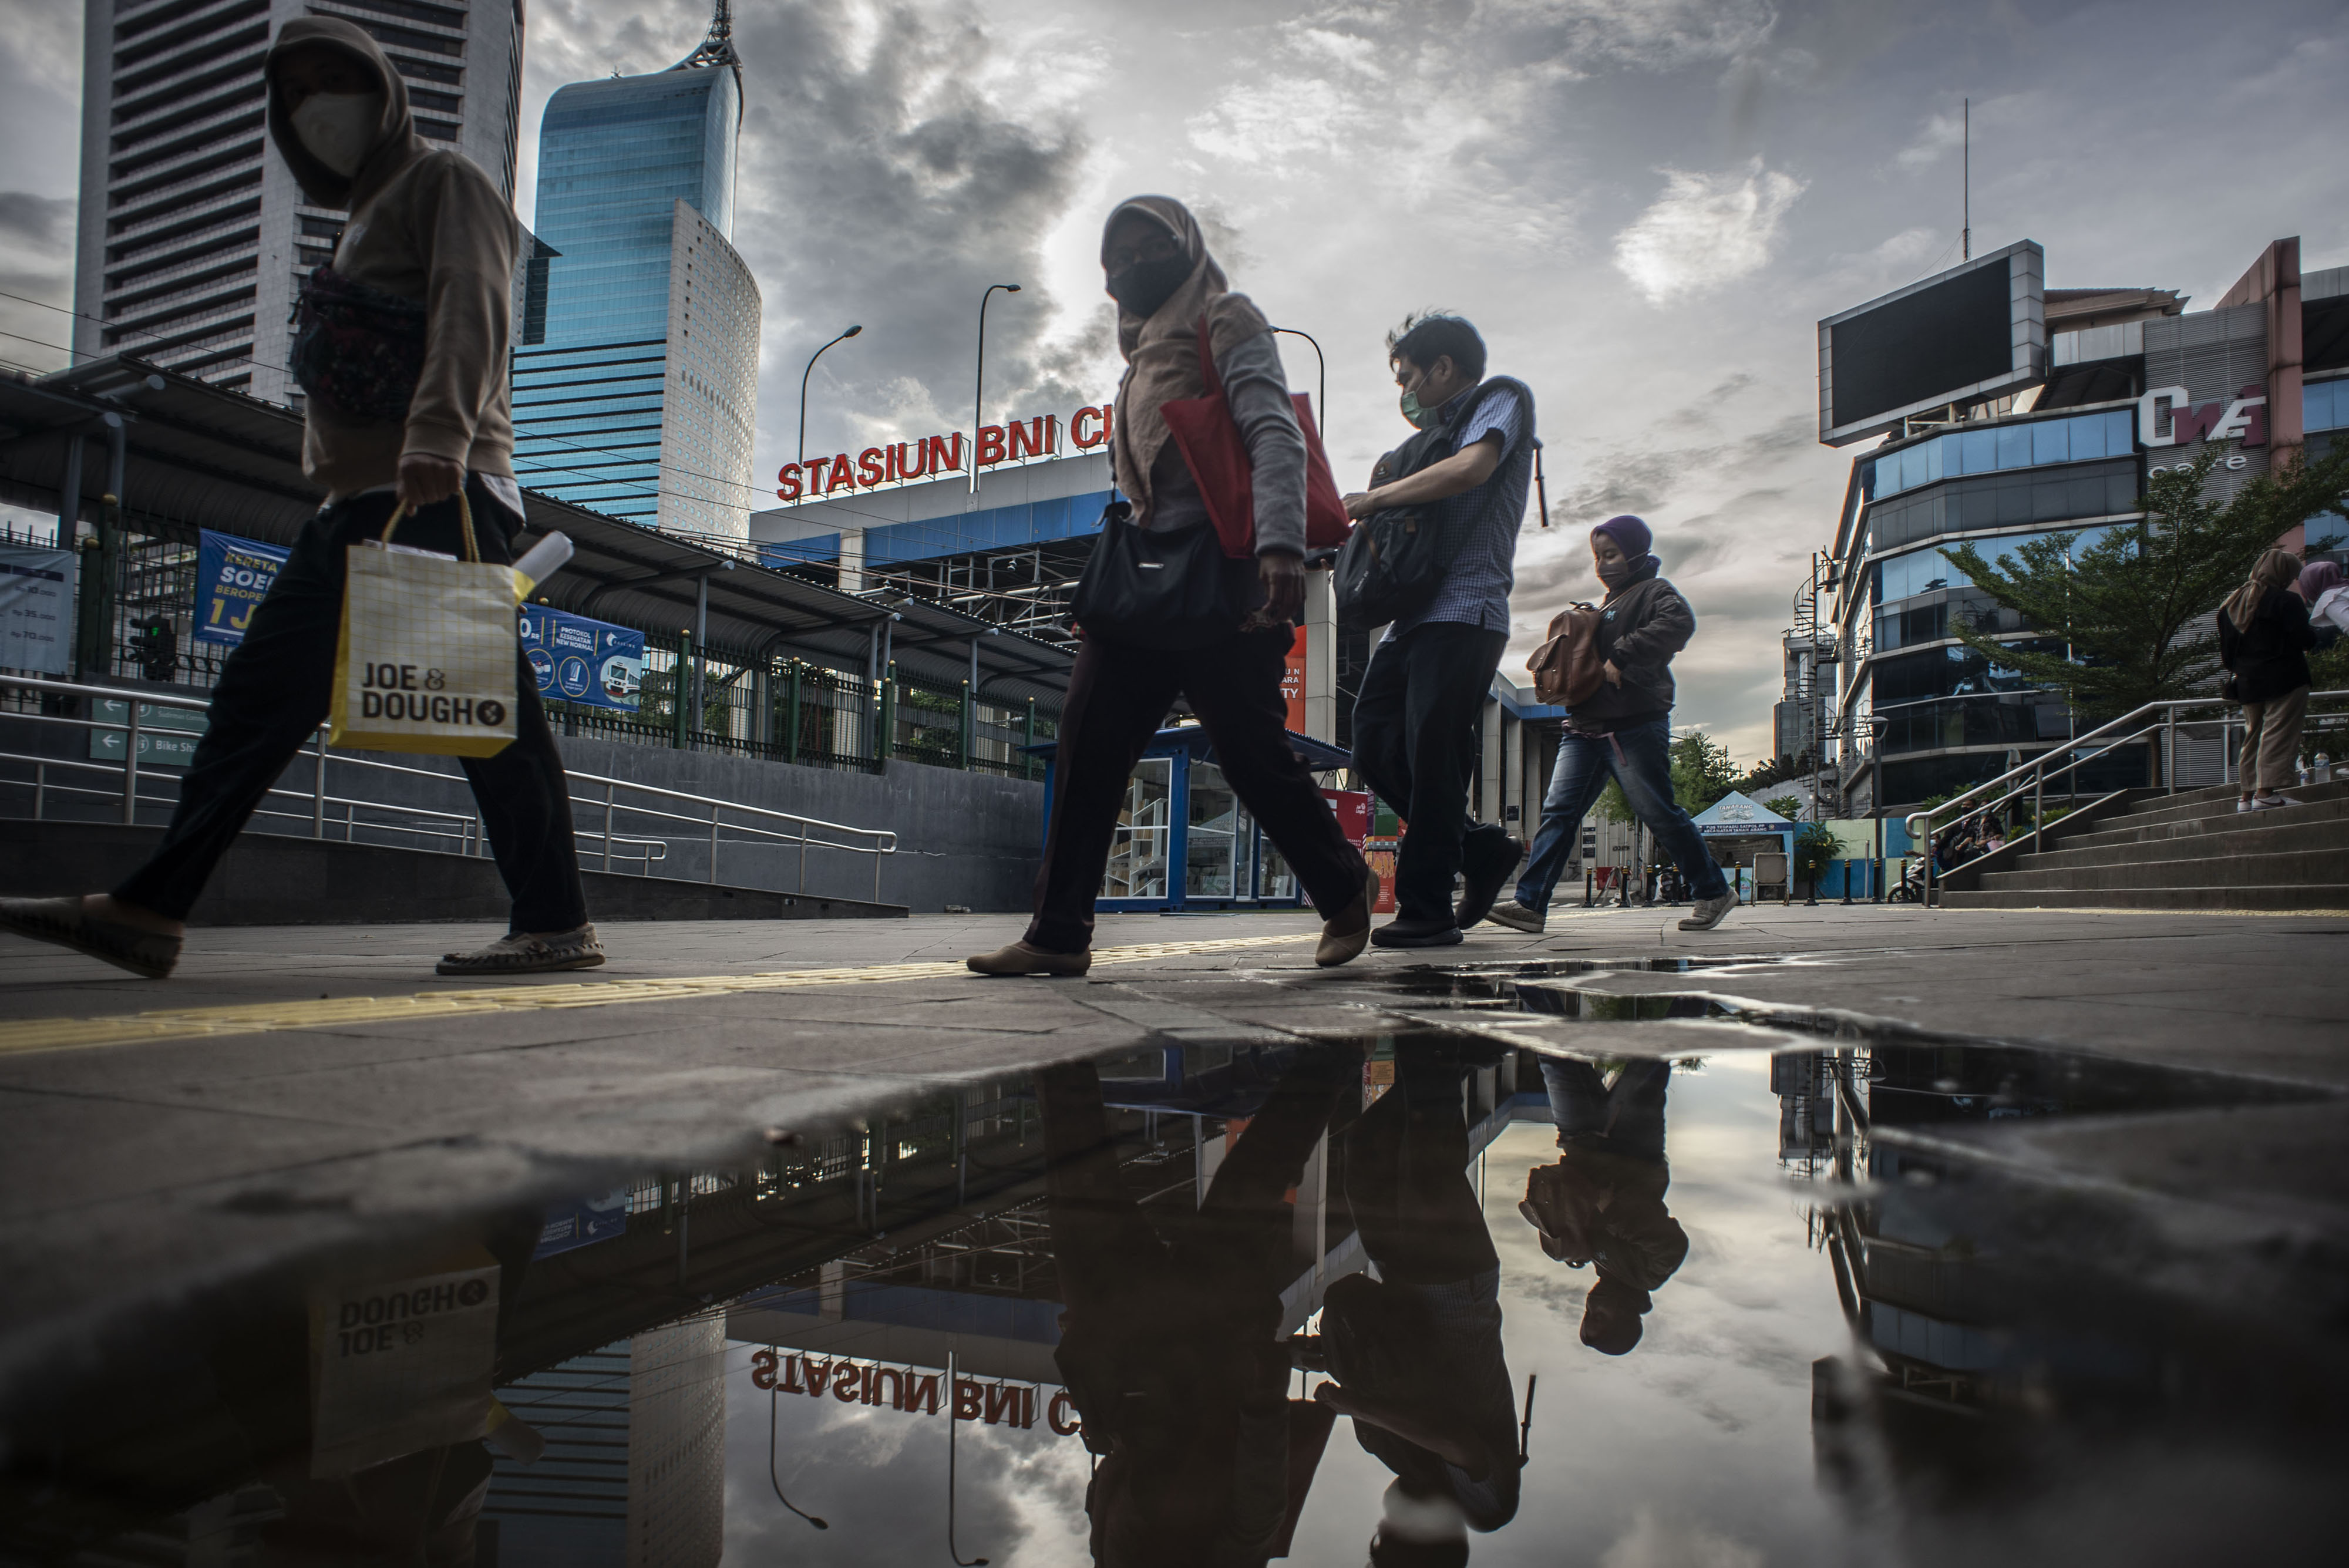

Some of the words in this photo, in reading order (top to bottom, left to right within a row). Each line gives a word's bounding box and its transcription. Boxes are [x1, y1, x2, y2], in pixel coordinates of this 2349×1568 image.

[776, 431, 962, 501] STASIUN
[977, 413, 1056, 466] BNI
[224, 553, 278, 573] KERETA
[214, 584, 267, 602] BEROPE
[209, 597, 226, 624] 1
[559, 632, 592, 645] KESEHATAN
[561, 626, 591, 638] PROTOKOL
[556, 638, 570, 647] NEW
[570, 641, 594, 651] NORMAL
[362, 662, 417, 690] JOE
[424, 668, 445, 691] &
[362, 692, 472, 725] DOUGH
[156, 740, 177, 751] Bike
